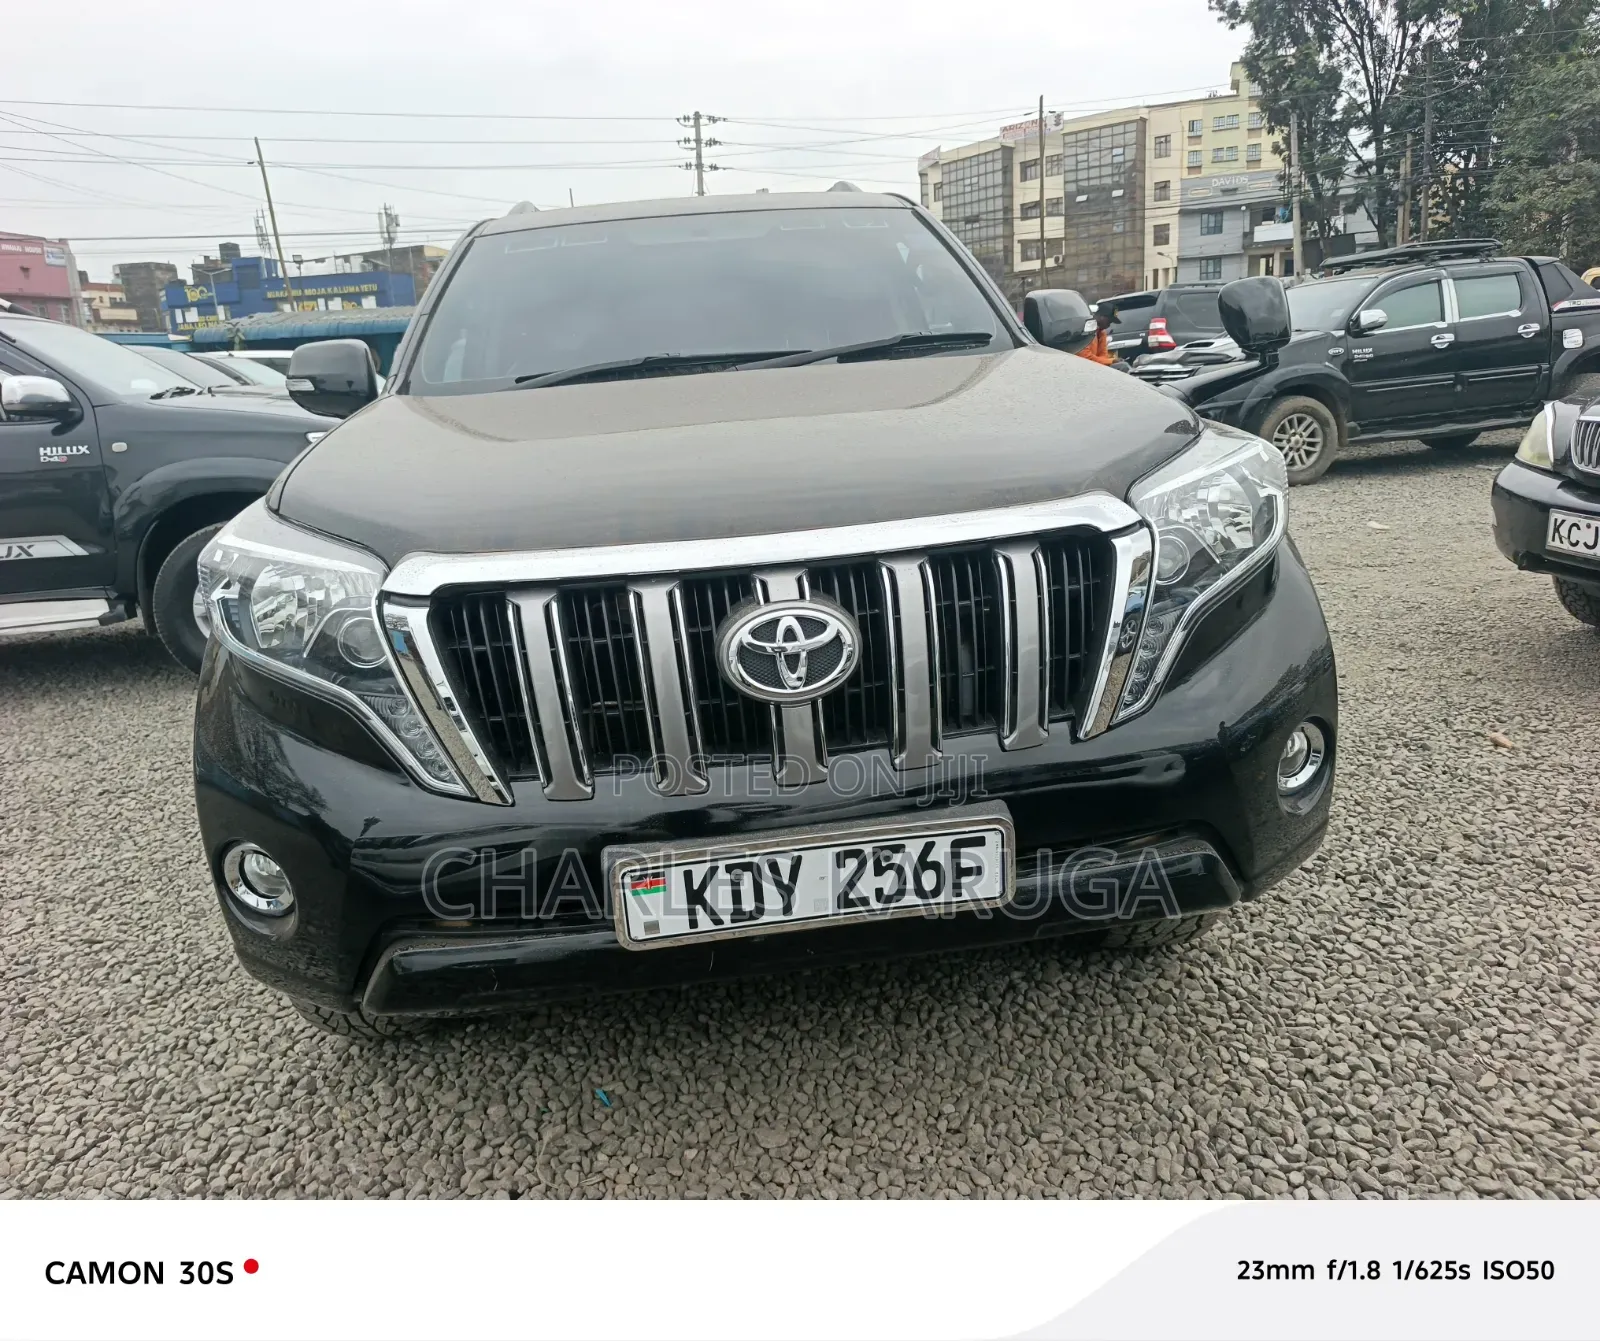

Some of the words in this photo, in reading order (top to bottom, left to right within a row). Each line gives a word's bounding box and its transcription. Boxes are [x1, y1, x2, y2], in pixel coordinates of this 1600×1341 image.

[360, 284, 378, 293] YETU
[39, 445, 91, 456] HILUX
[1551, 517, 1599, 550] KCJ
[683, 855, 802, 929] KDY
[835, 835, 986, 910] 256F
